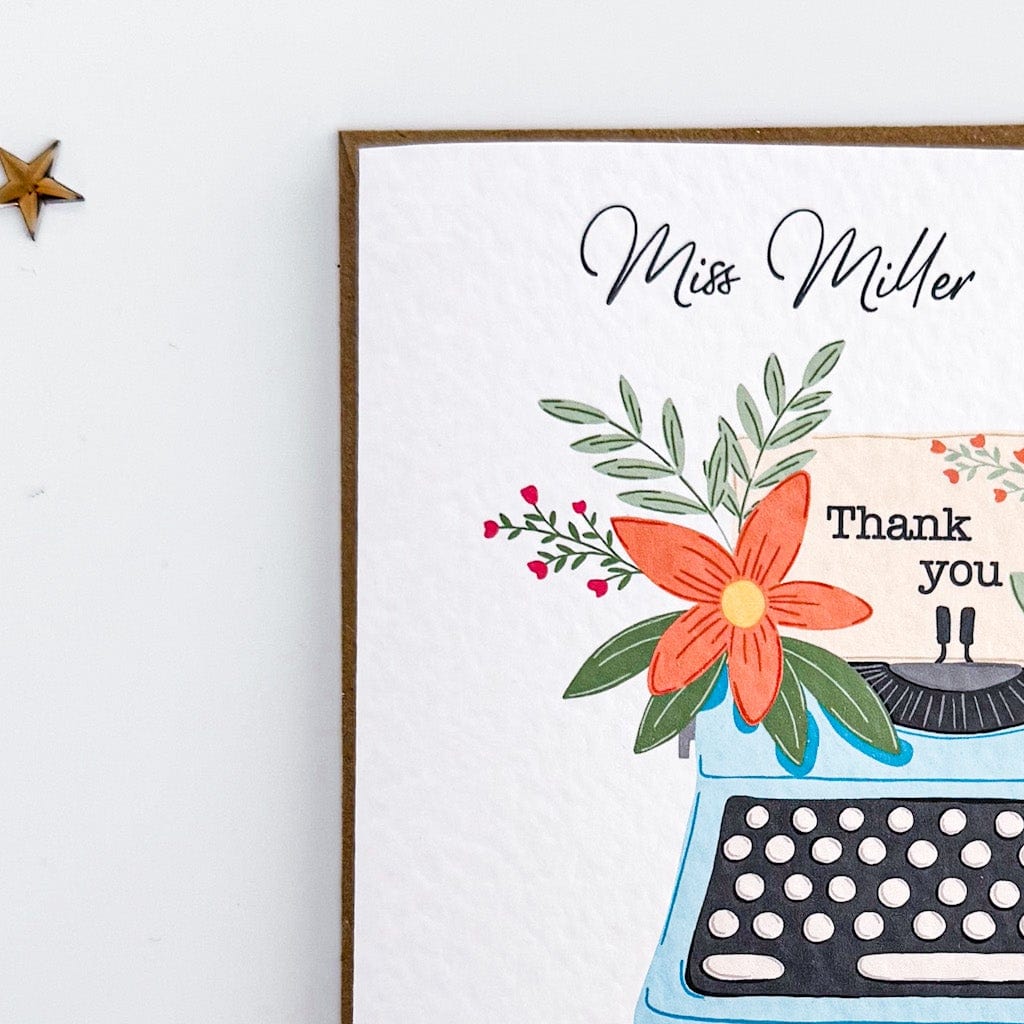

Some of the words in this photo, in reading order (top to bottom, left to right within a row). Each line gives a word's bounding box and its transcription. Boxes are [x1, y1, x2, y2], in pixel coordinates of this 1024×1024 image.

[580, 204, 741, 308] Miss
[766, 208, 976, 313] Miller
[826, 505, 973, 542] Thank
[917, 560, 1004, 595] you
